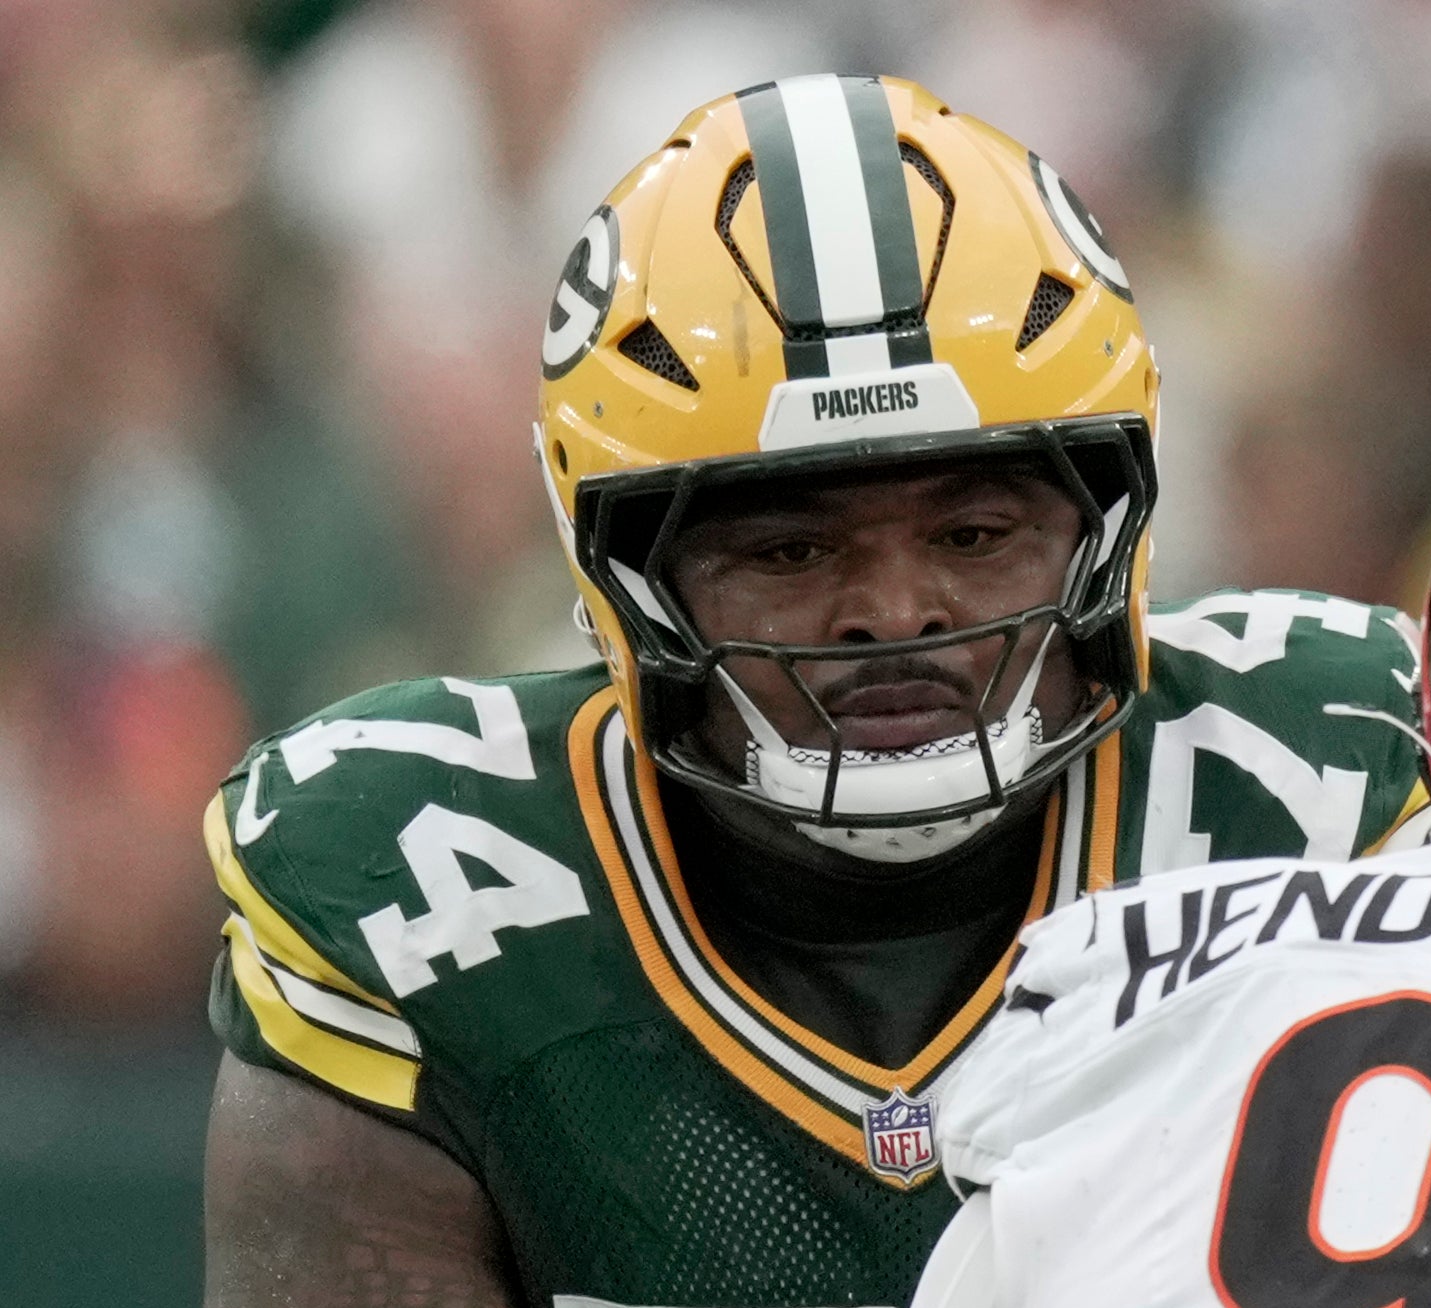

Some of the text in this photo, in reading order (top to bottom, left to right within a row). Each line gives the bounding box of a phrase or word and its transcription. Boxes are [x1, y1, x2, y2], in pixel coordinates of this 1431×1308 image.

[542, 213, 612, 366] G
[812, 381, 919, 421] PACKERS
[280, 676, 590, 998] 74
[878, 1131, 930, 1167] NFL
